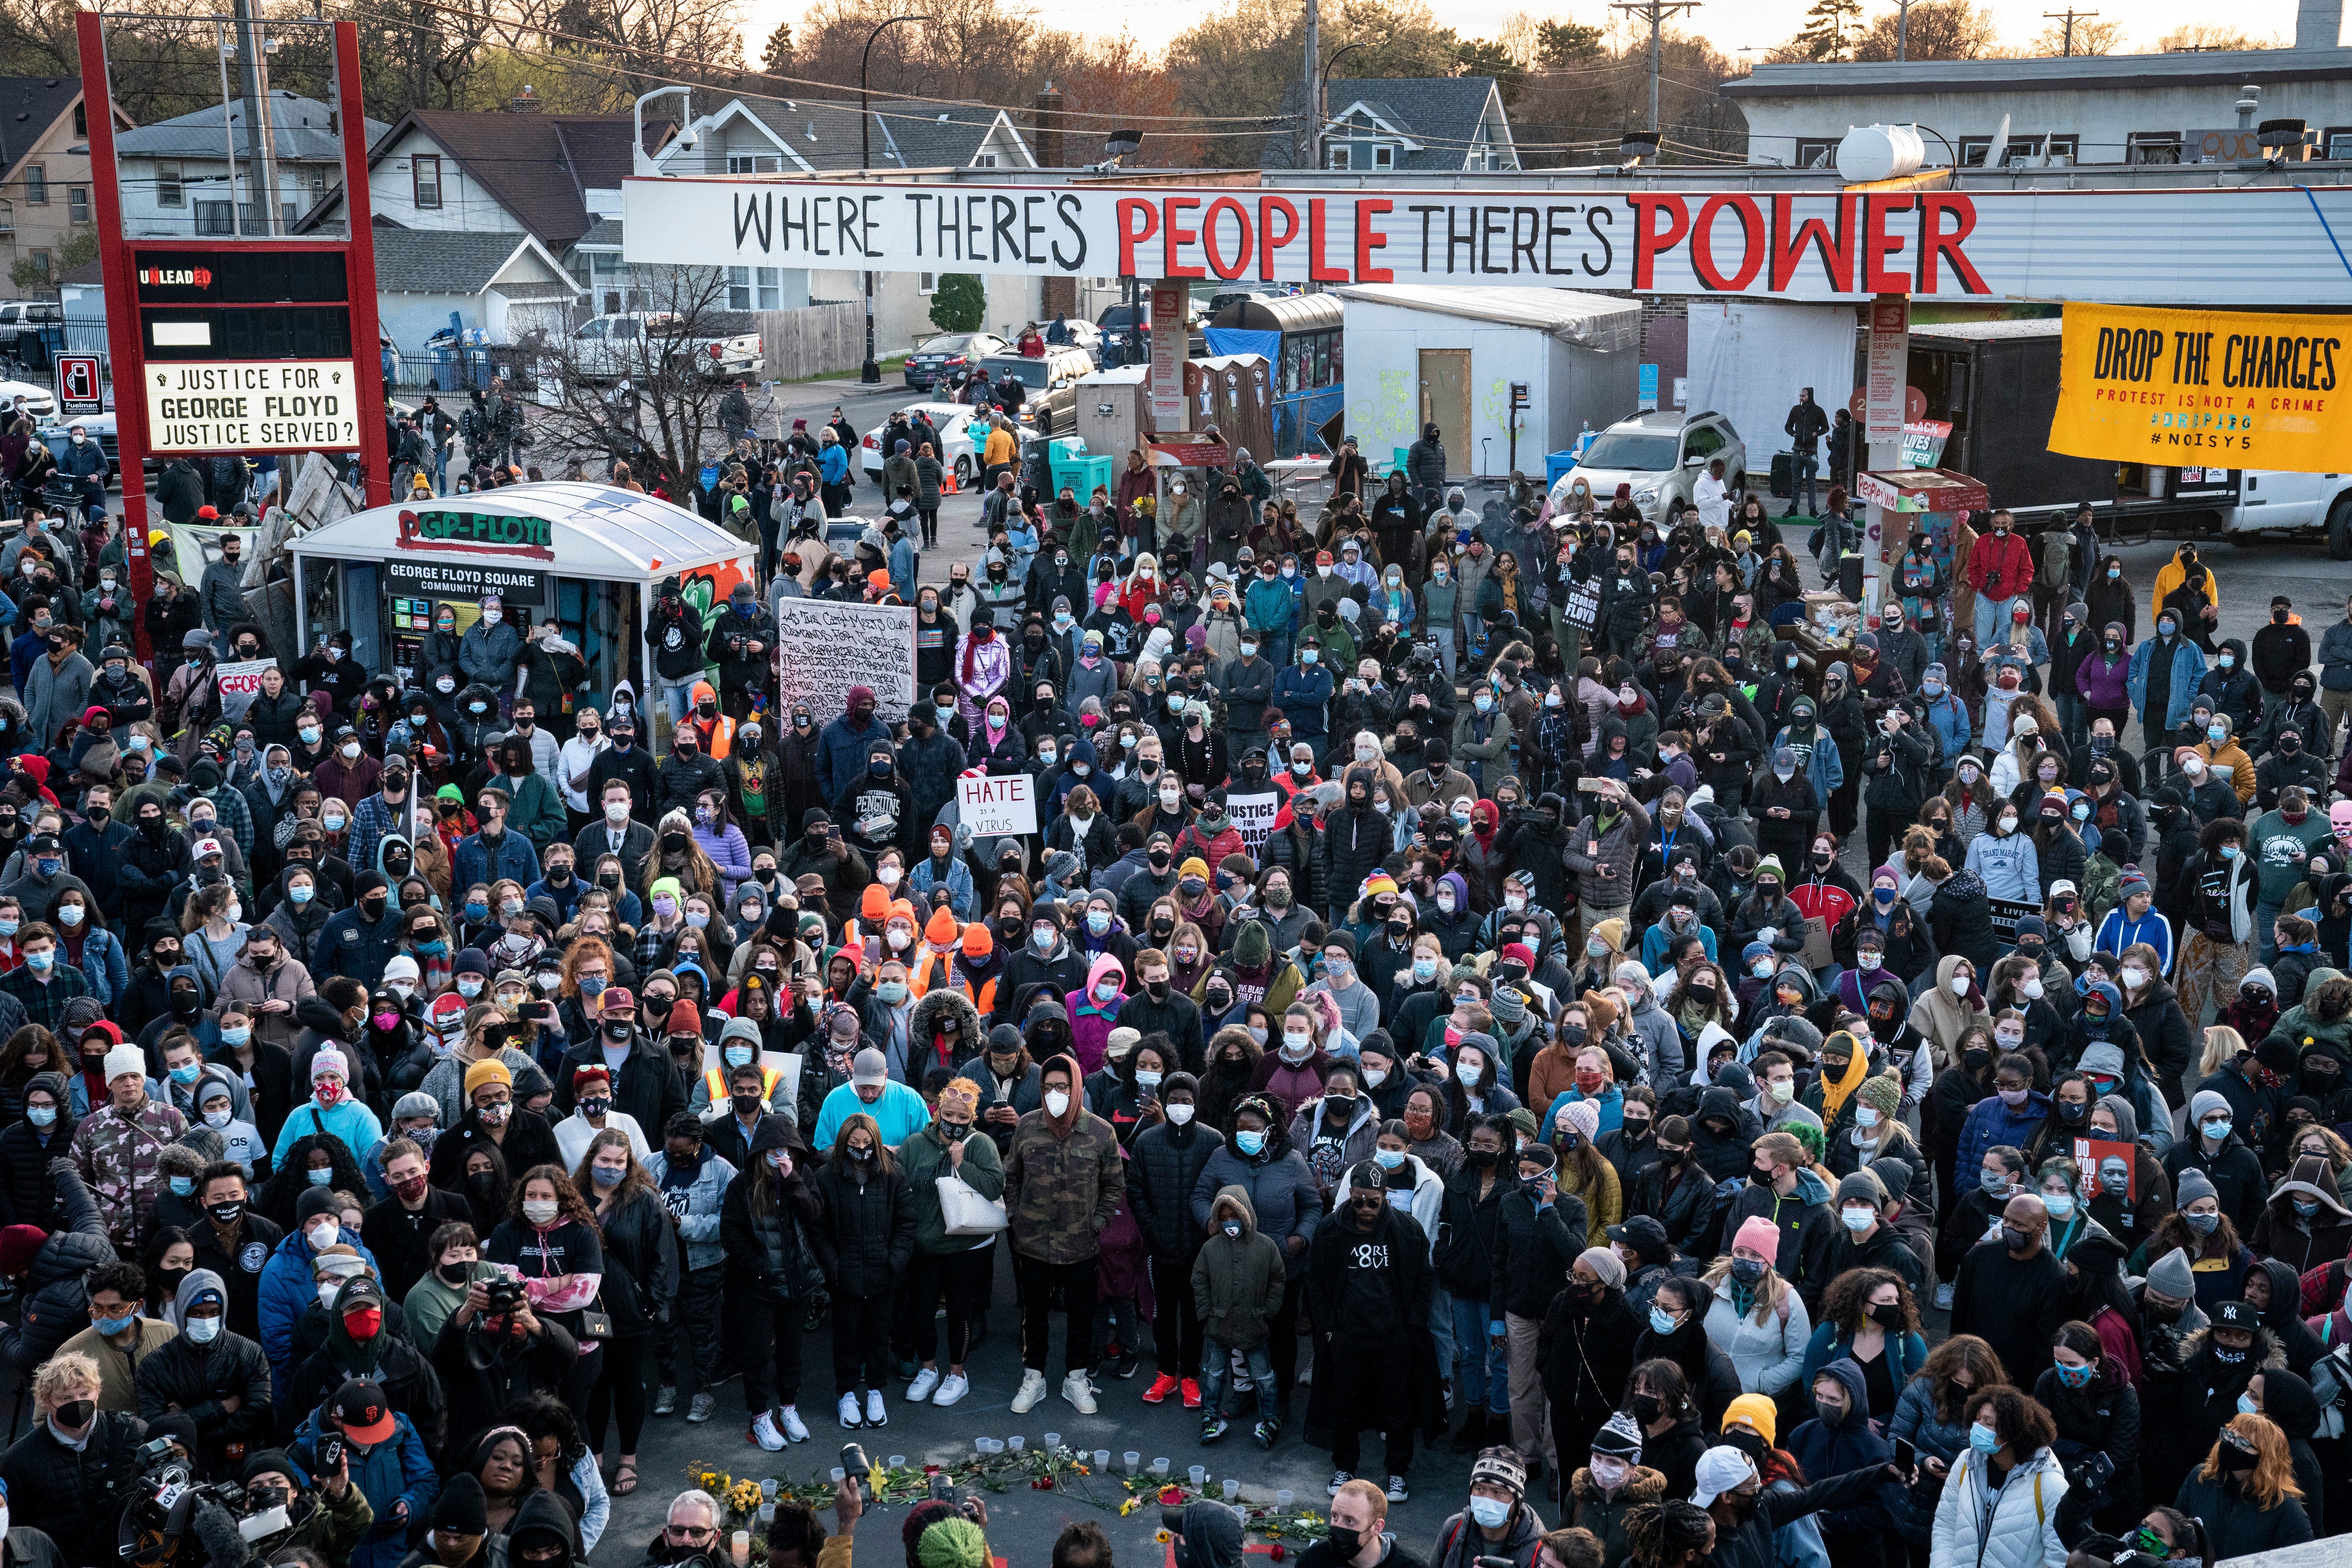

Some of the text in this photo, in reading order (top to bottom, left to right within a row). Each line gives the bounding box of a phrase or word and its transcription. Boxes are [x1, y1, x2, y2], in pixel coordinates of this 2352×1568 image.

[734, 190, 1993, 294] WHERE THERE'S PEOPLE THERE'S POWER
[2094, 327, 2340, 392] DROP THE CHARGES
[178, 368, 319, 390] JUSTICE FOR
[1188, 374, 1196, 385] 3
[162, 396, 338, 418] GEORGE FLOYD
[1857, 398, 1865, 411] 2
[1911, 400, 1916, 412] 1
[2096, 388, 2325, 412] PROTEST IS NOT A CRIME
[162, 423, 250, 445] JUSTICE
[1904, 422, 1939, 434] BLACK
[1902, 434, 1930, 450] LIVES
[390, 564, 535, 587] GEORGE FLOYD SQUARE
[421, 581, 504, 596] COMMUNITY INFO
[1569, 593, 1599, 611] GEORGE
[1564, 605, 1595, 624] FLOYD
[967, 779, 1024, 804] HATE
[857, 796, 900, 817] PENGUINS
[976, 819, 1013, 833] VIRUS
[1982, 849, 1999, 859] GRAND
[2075, 1140, 2090, 1158] DO
